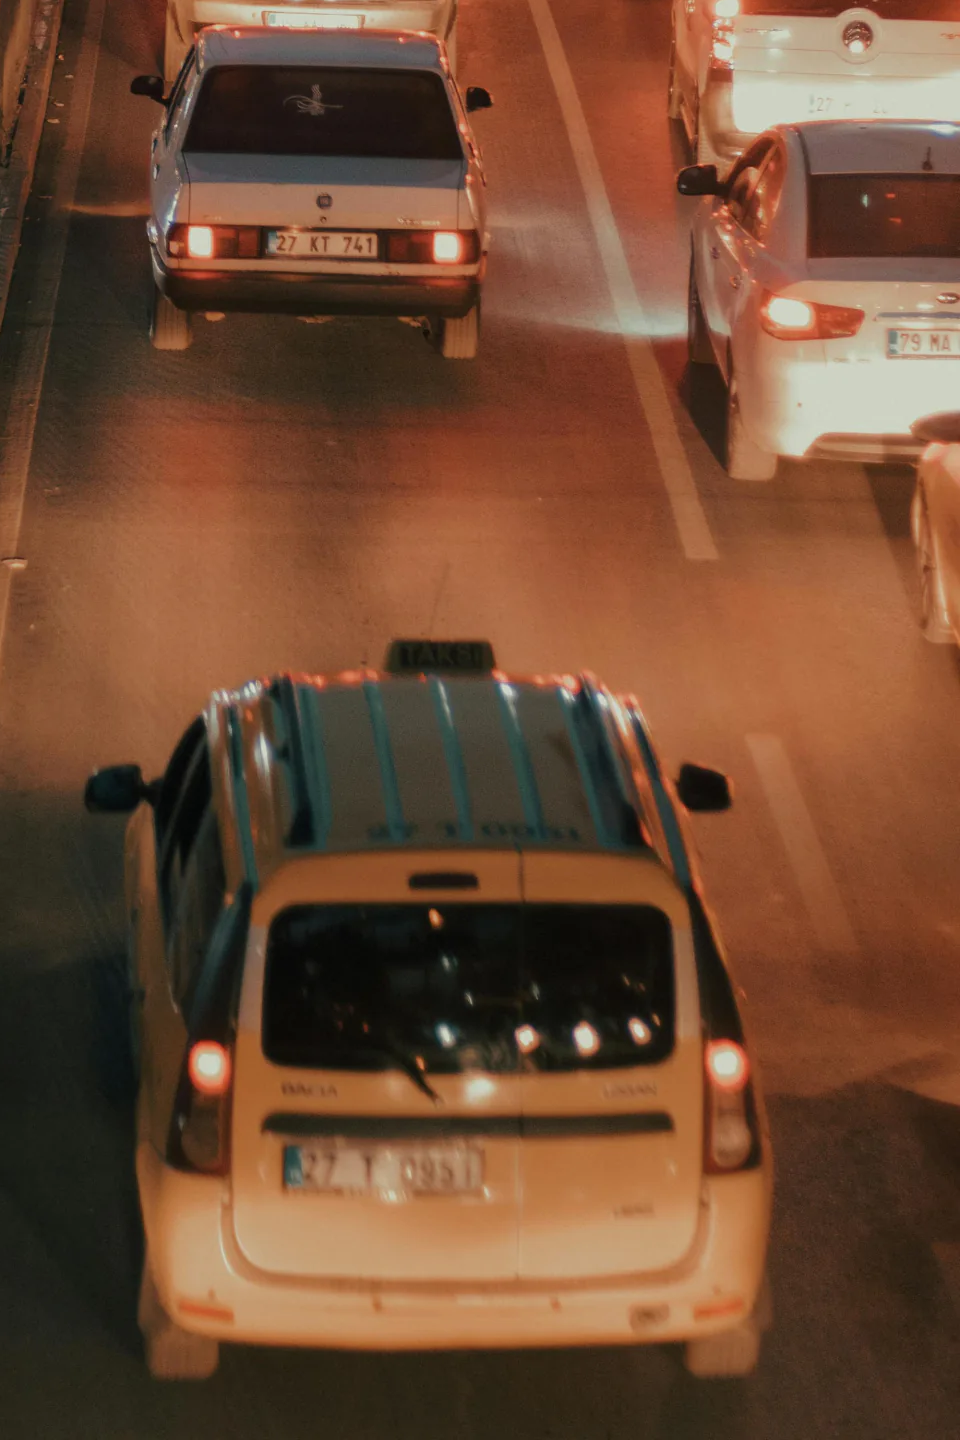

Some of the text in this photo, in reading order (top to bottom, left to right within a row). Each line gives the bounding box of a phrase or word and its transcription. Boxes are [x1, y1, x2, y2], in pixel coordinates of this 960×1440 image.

[277, 235, 372, 254] 27 KT 741
[900, 333, 951, 352] 79 MA
